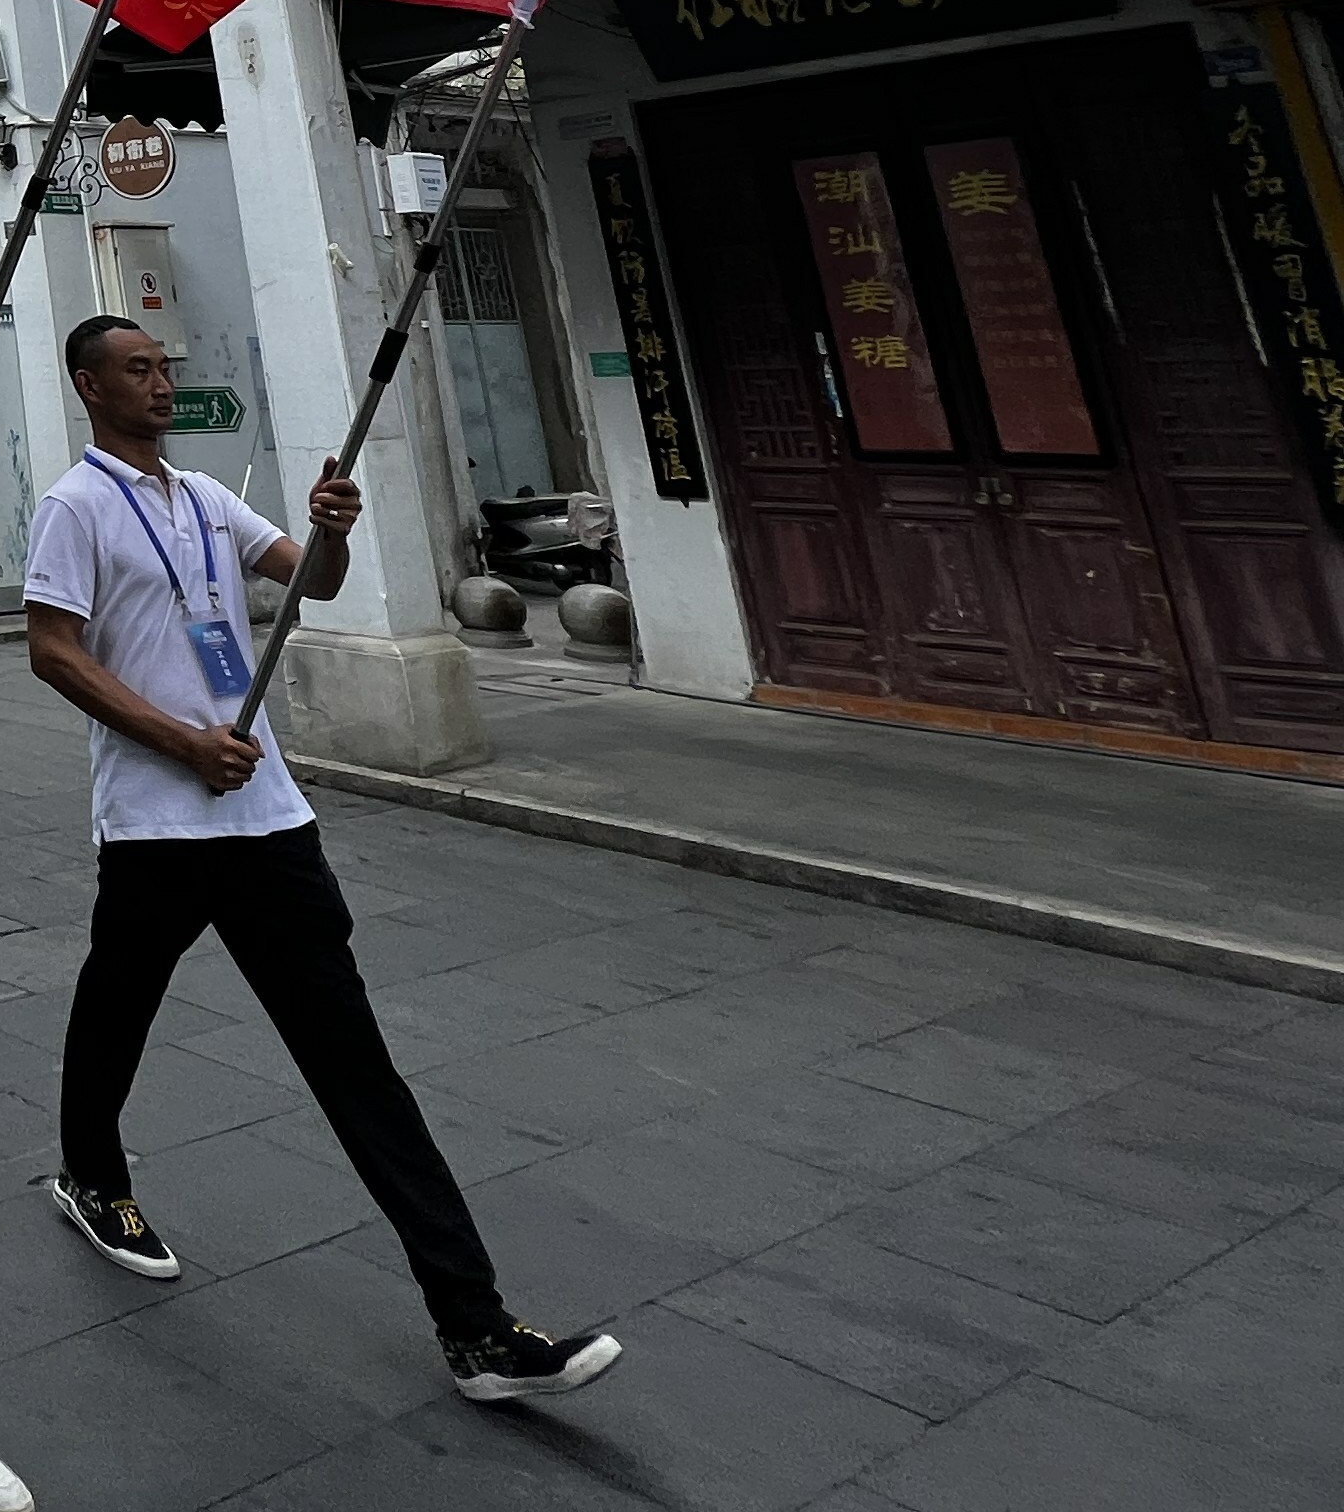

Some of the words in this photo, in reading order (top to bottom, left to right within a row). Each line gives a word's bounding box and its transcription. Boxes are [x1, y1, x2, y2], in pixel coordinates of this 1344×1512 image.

[947, 169, 1018, 216] 姜
[814, 169, 910, 369] 潮汕姜糖
